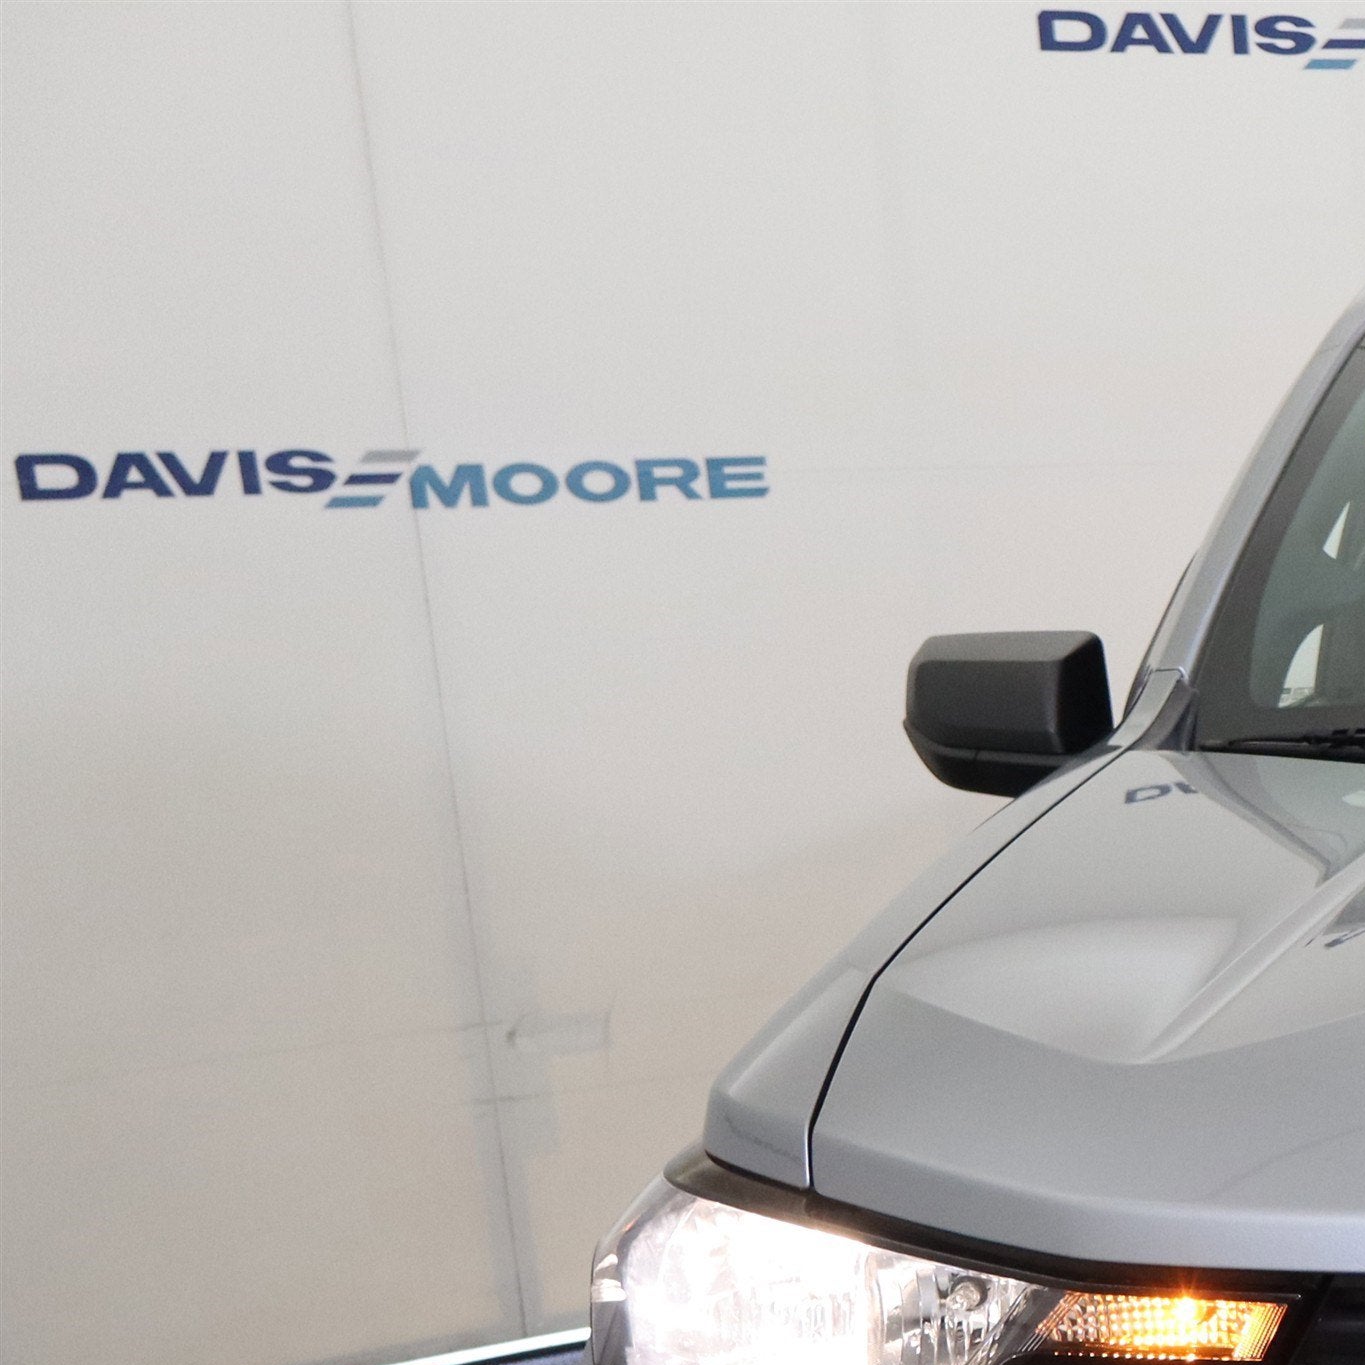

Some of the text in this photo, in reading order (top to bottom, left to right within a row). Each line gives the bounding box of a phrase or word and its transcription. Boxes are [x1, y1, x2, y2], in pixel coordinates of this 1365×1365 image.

[1037, 10, 1315, 55] DAVIS
[14, 449, 770, 509] DAVIS MOORE
